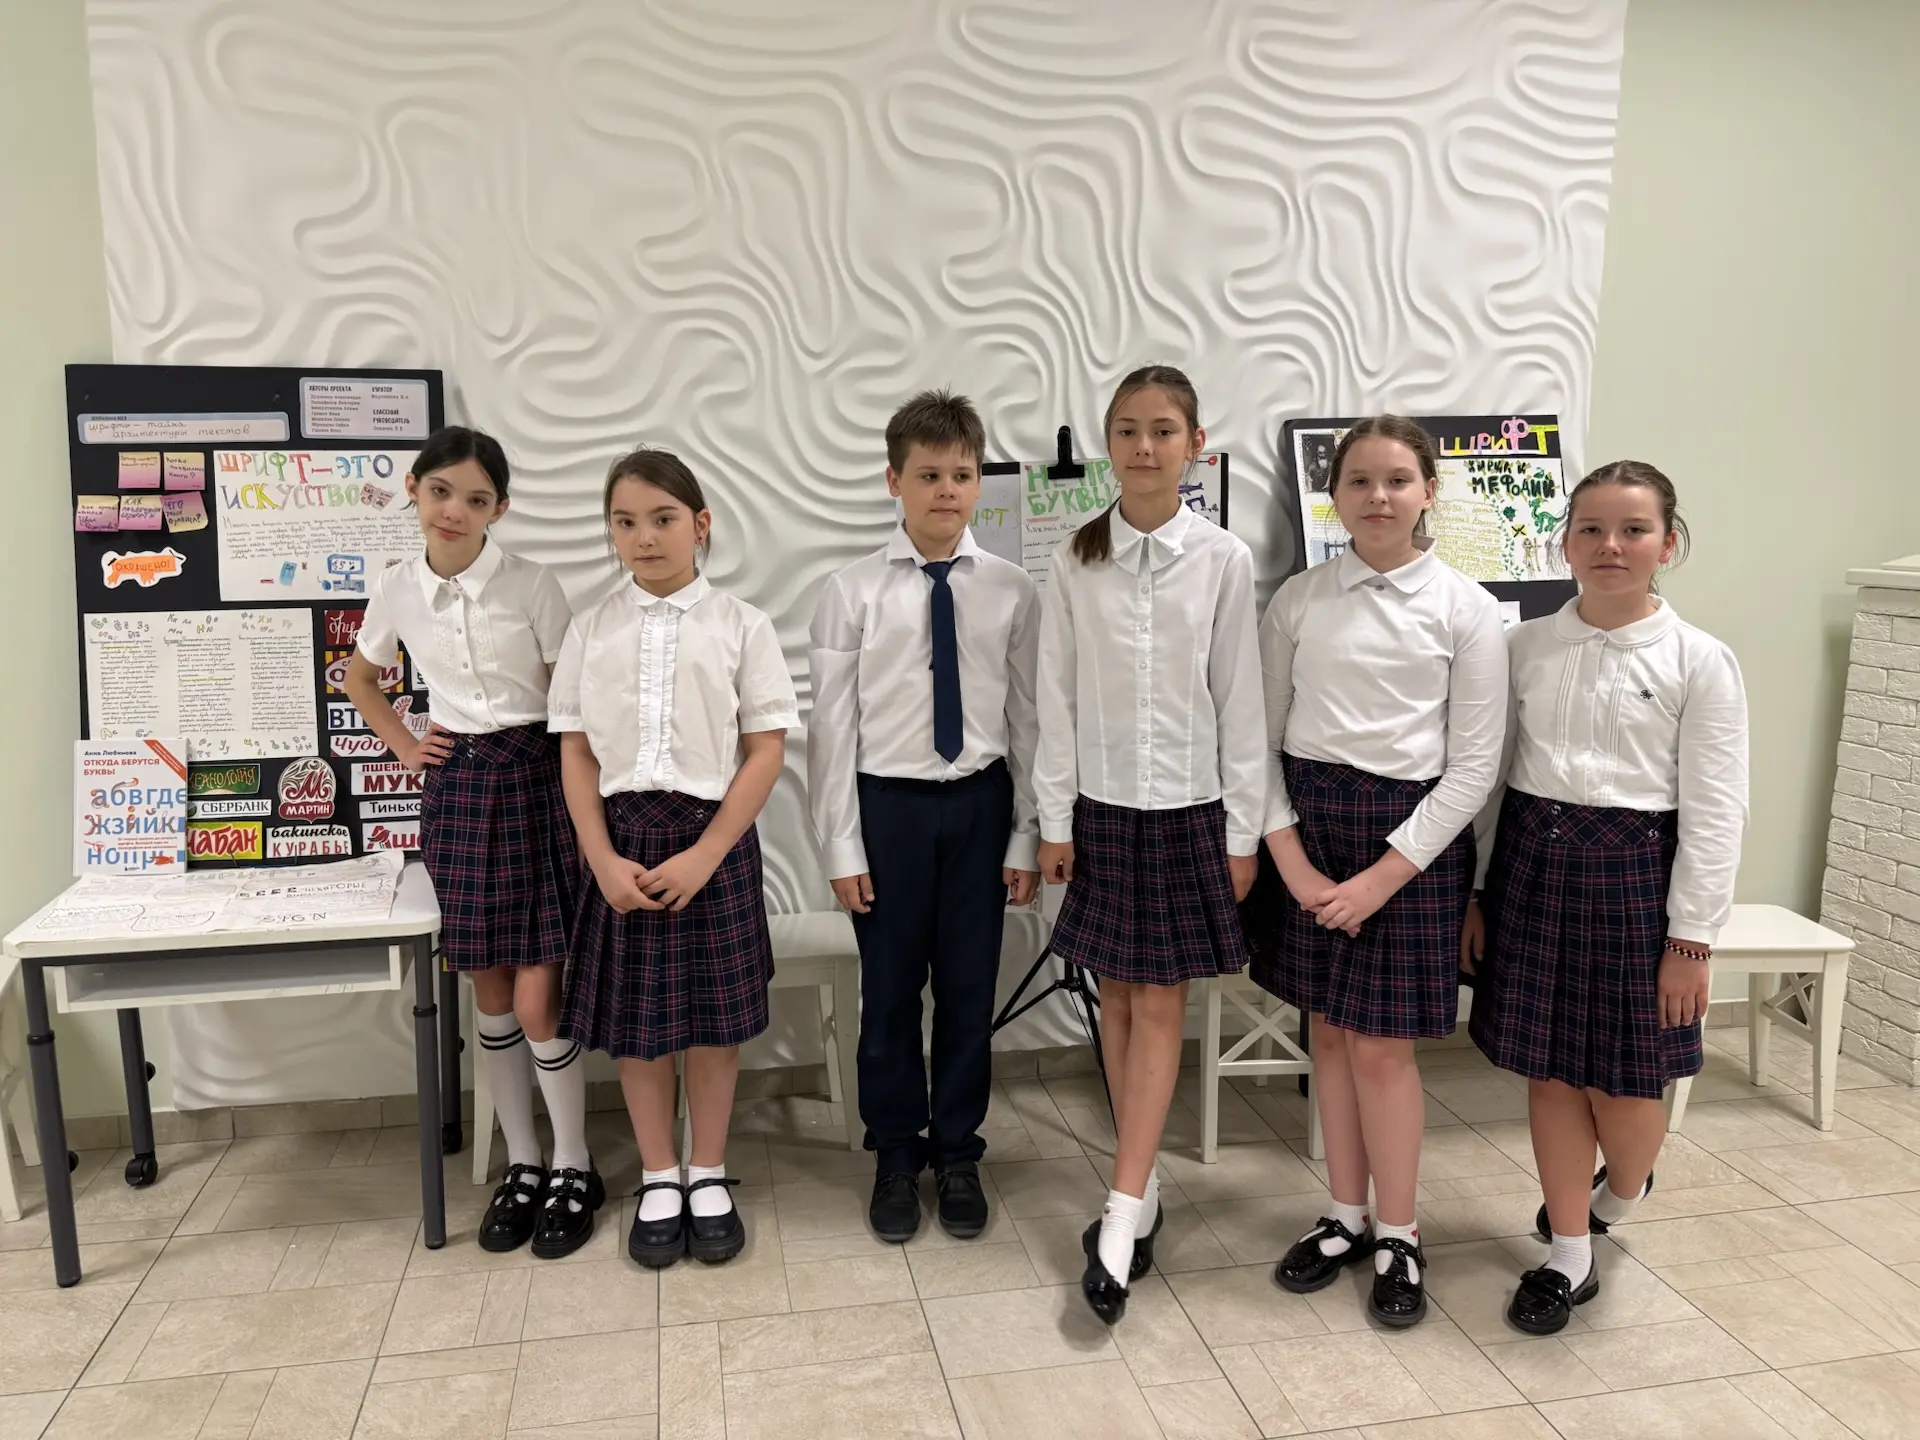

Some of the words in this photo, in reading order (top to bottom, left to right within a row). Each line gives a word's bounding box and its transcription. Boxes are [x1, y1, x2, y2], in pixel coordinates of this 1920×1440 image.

[198, 424, 250, 436] текстов
[1440, 417, 1558, 456] ШРИФТ
[220, 483, 360, 511] ИСКУССТВО
[1027, 483, 1112, 516] БУКВЫ
[335, 736, 386, 755] Чудо
[121, 758, 160, 766] БЕРУТСЯ
[201, 801, 269, 812] СБЕРБАНК
[286, 805, 329, 815] МАРТИН
[271, 825, 348, 838] бакинское
[273, 840, 348, 857] КУРАБЬЕ
